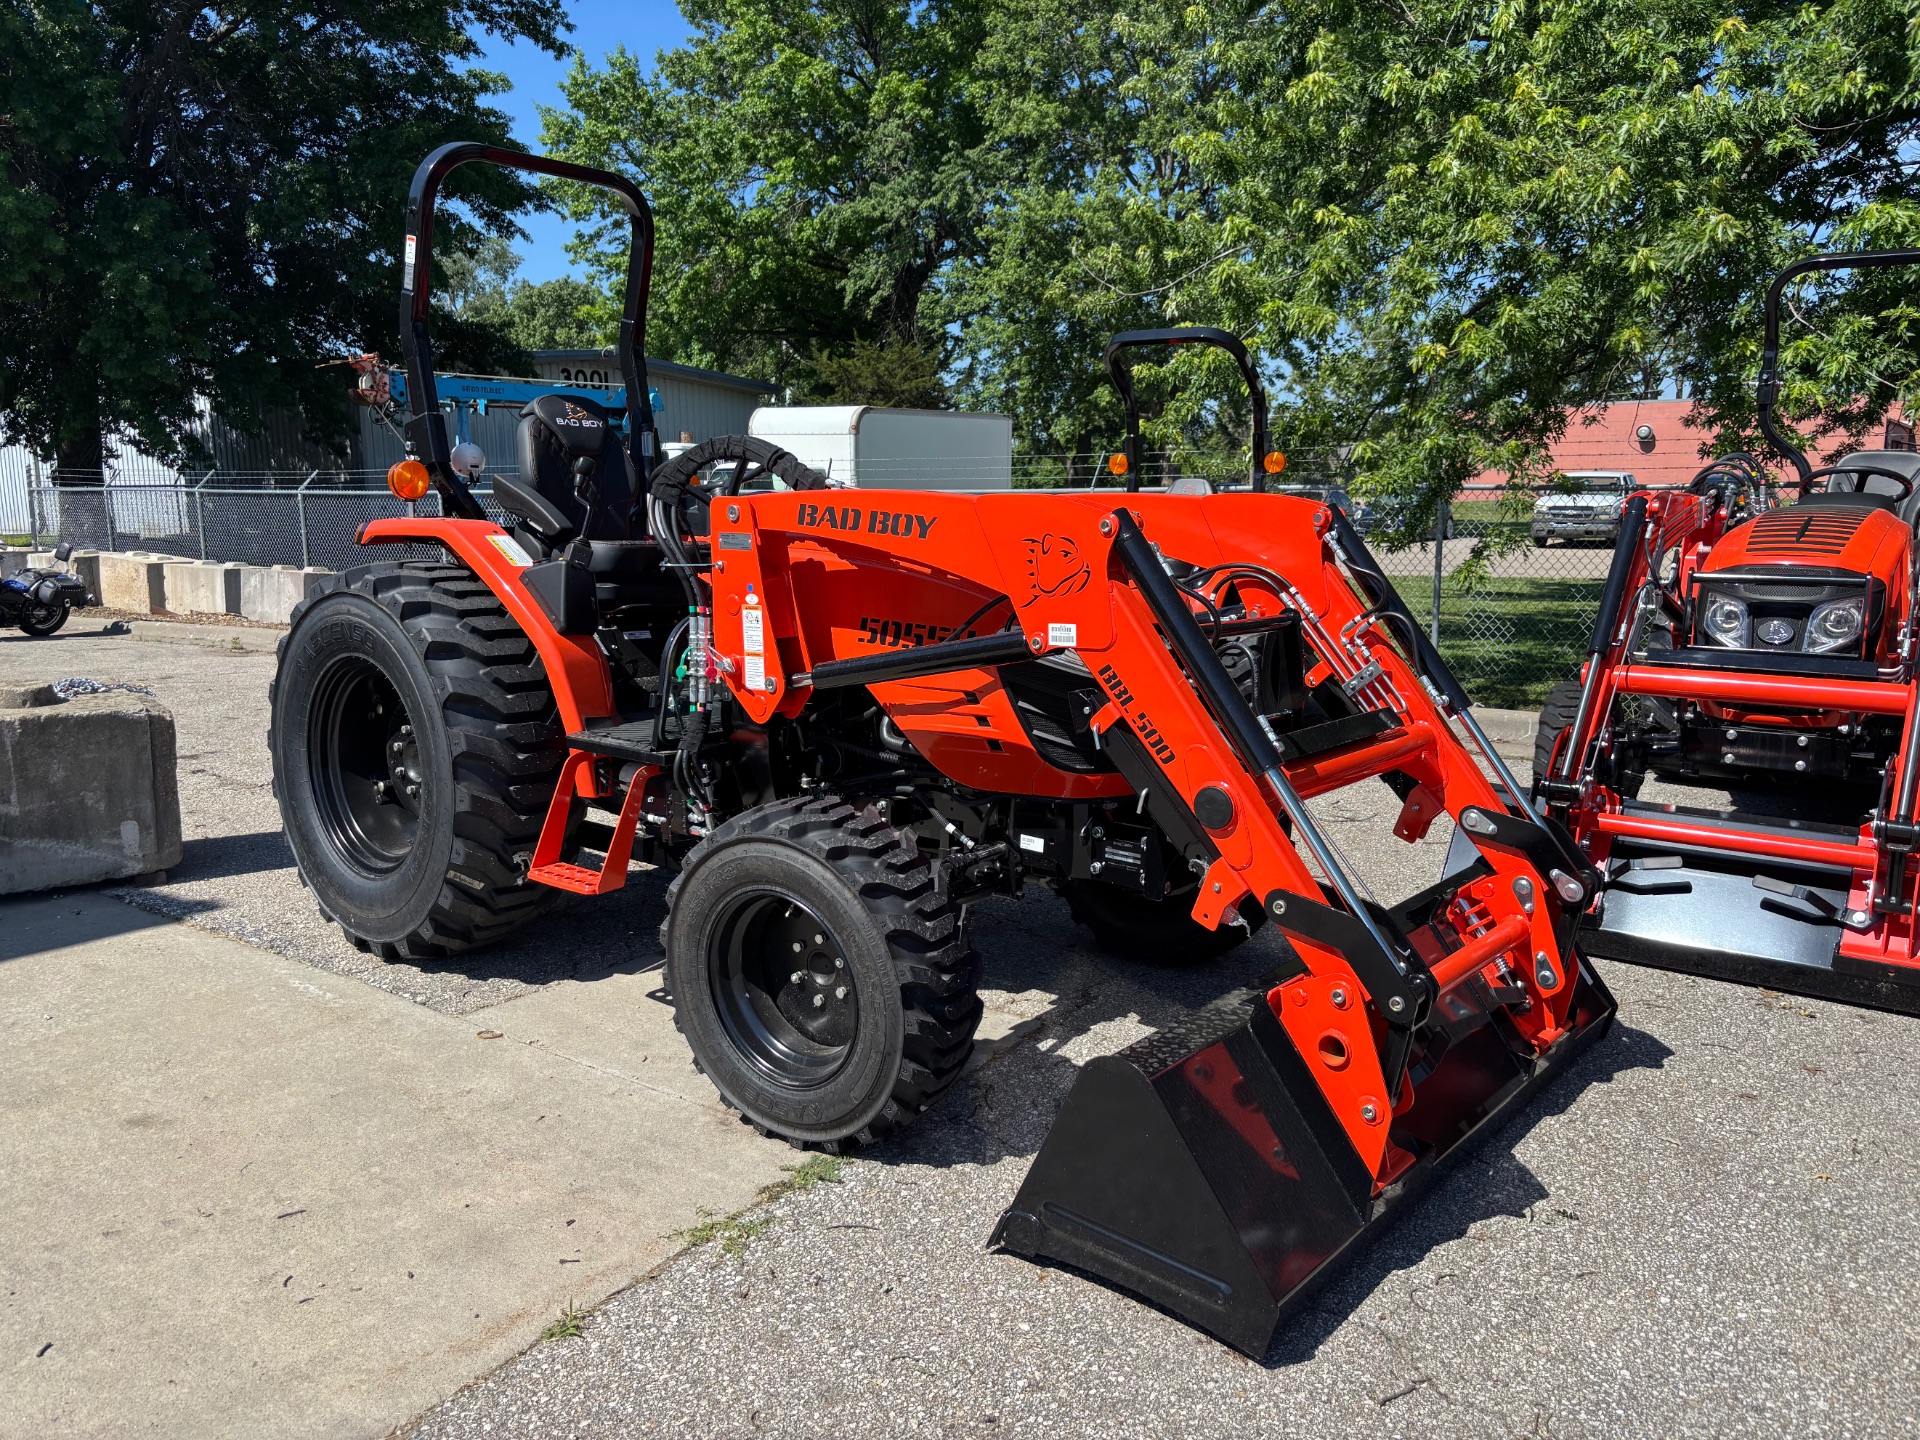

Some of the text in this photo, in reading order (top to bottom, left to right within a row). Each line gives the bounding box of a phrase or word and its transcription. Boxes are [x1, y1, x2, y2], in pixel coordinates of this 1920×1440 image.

[560, 367, 609, 390] 3001
[556, 417, 603, 428] BAD BOY
[797, 503, 938, 540] BAD BOY
[857, 616, 977, 649] 5055
[1097, 663, 1176, 765] BBL 500
[703, 1036, 808, 1120] ASCENSO
